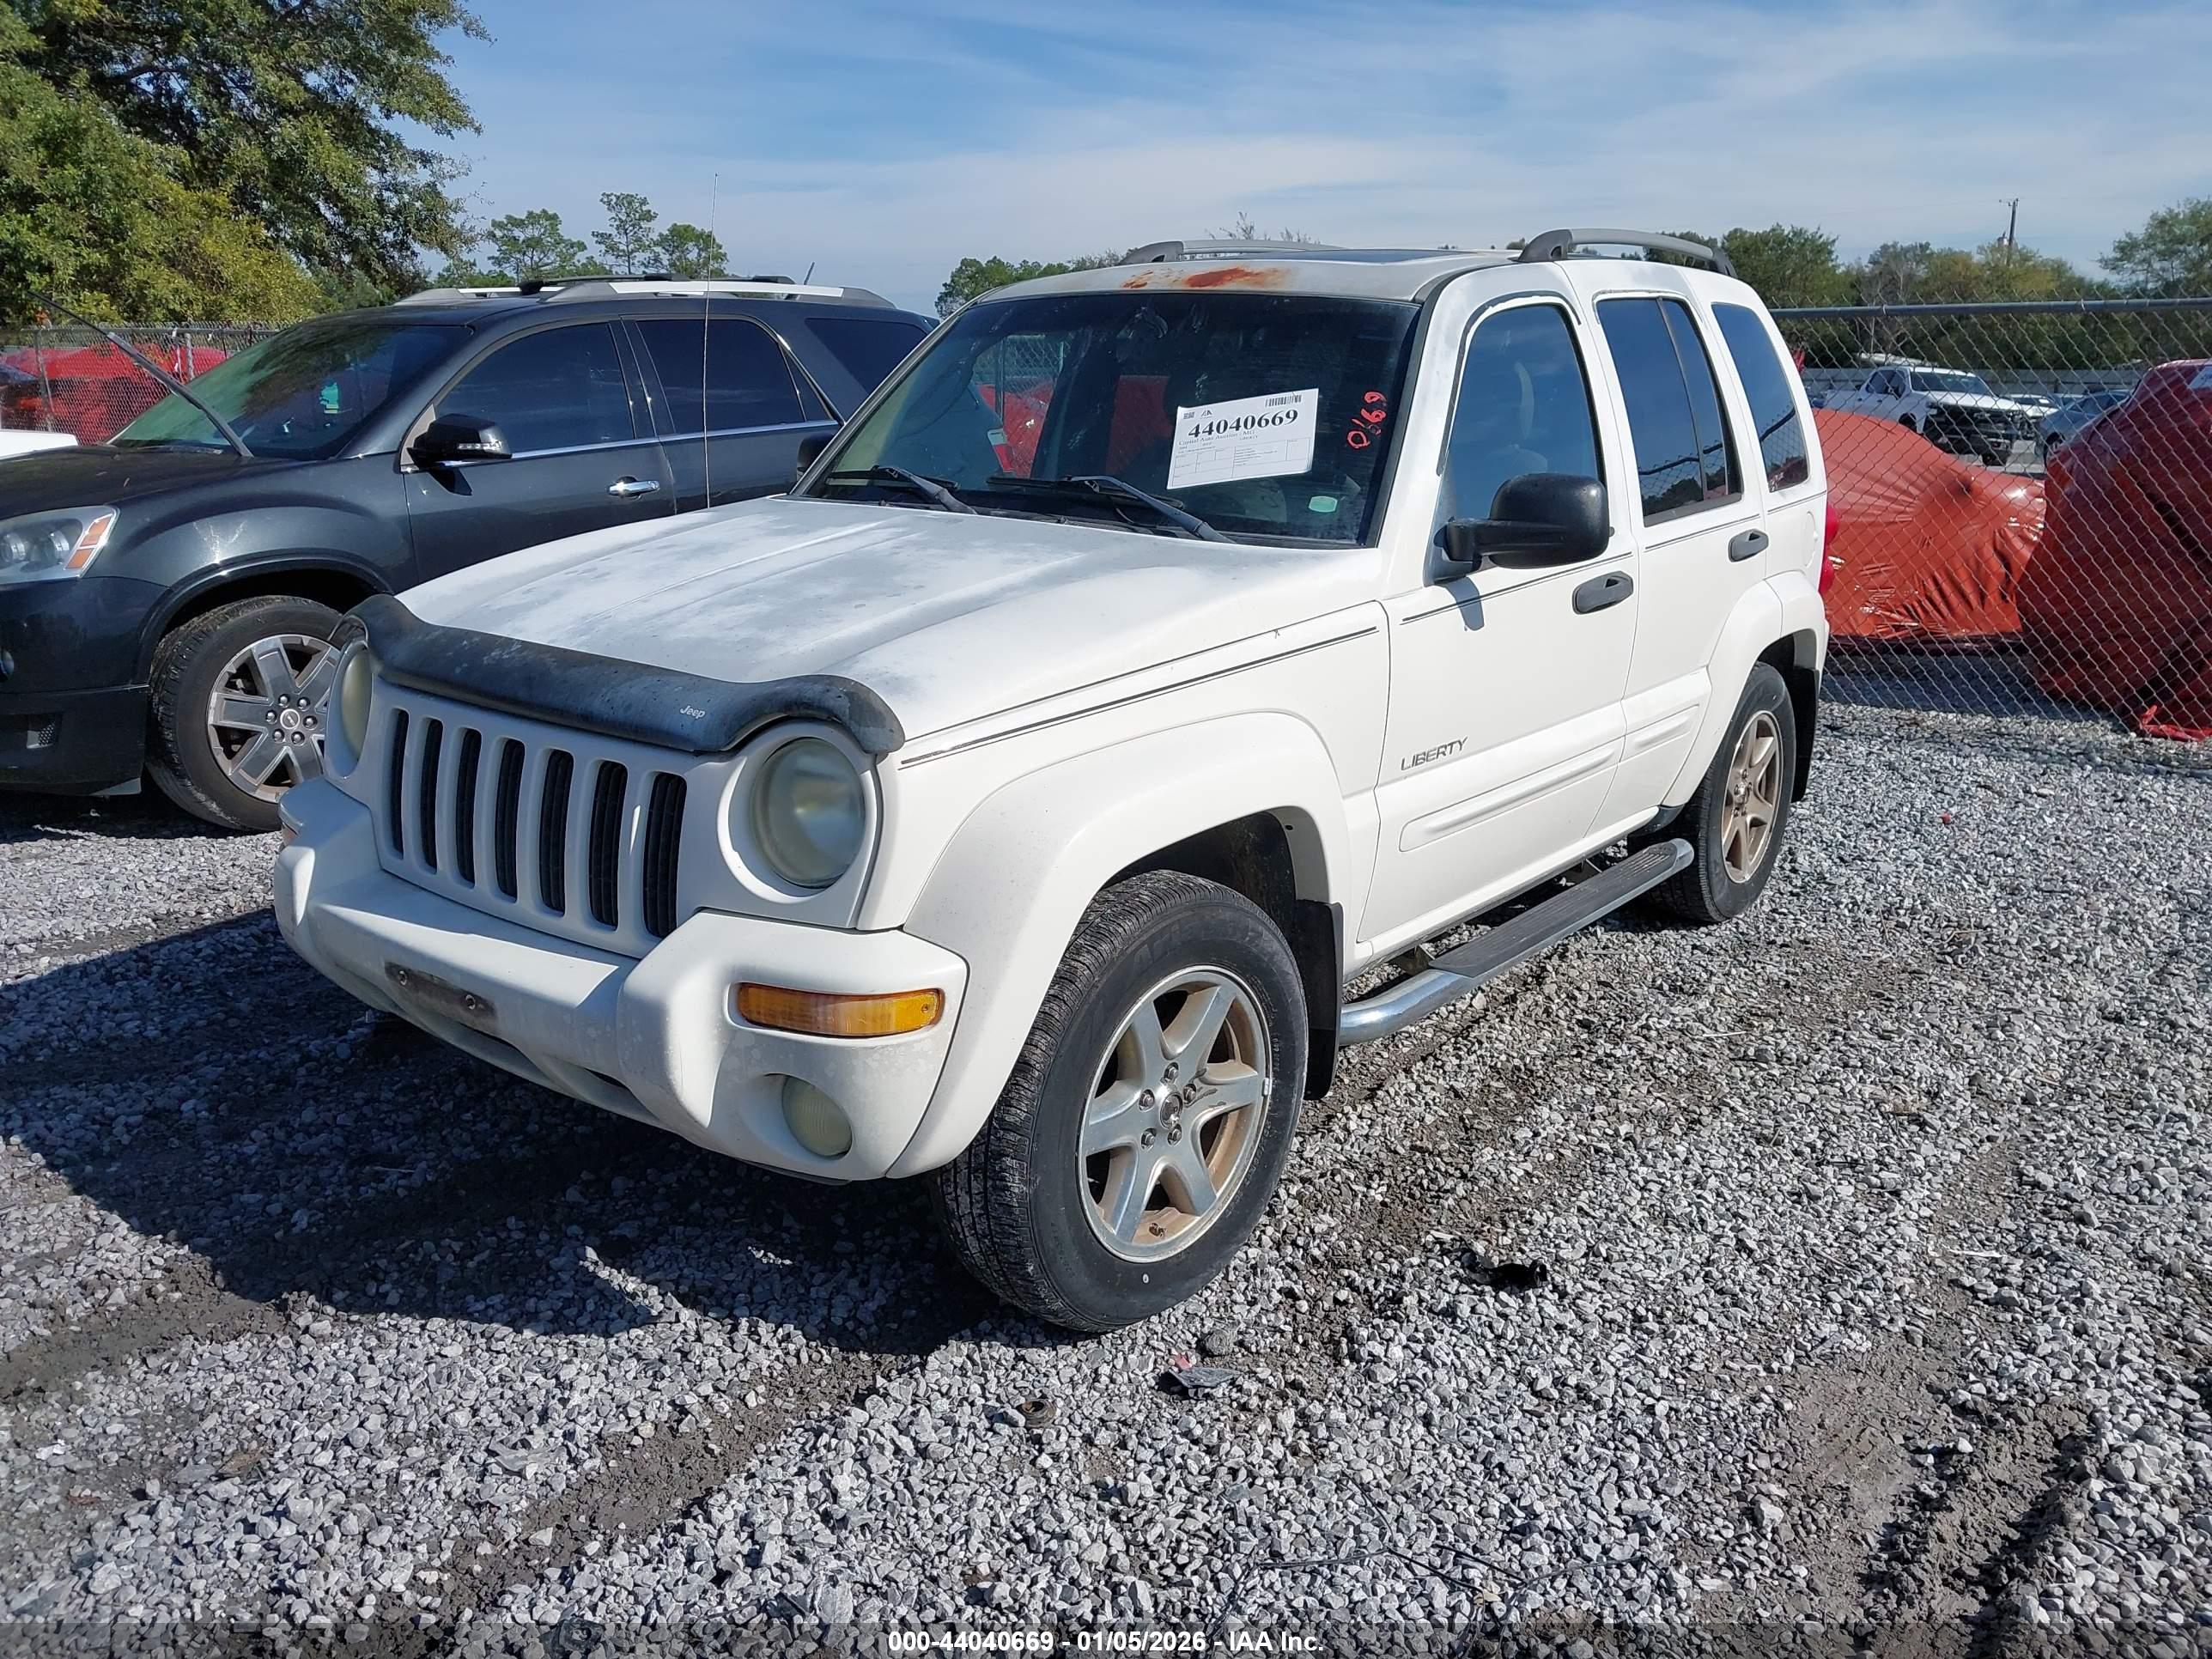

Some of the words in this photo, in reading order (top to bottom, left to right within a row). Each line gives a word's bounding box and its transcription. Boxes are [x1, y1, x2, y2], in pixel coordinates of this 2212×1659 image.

[1188, 409, 1298, 438] 44040669
[680, 705, 706, 719] Jeep
[1401, 736, 1468, 771] LIBERTY
